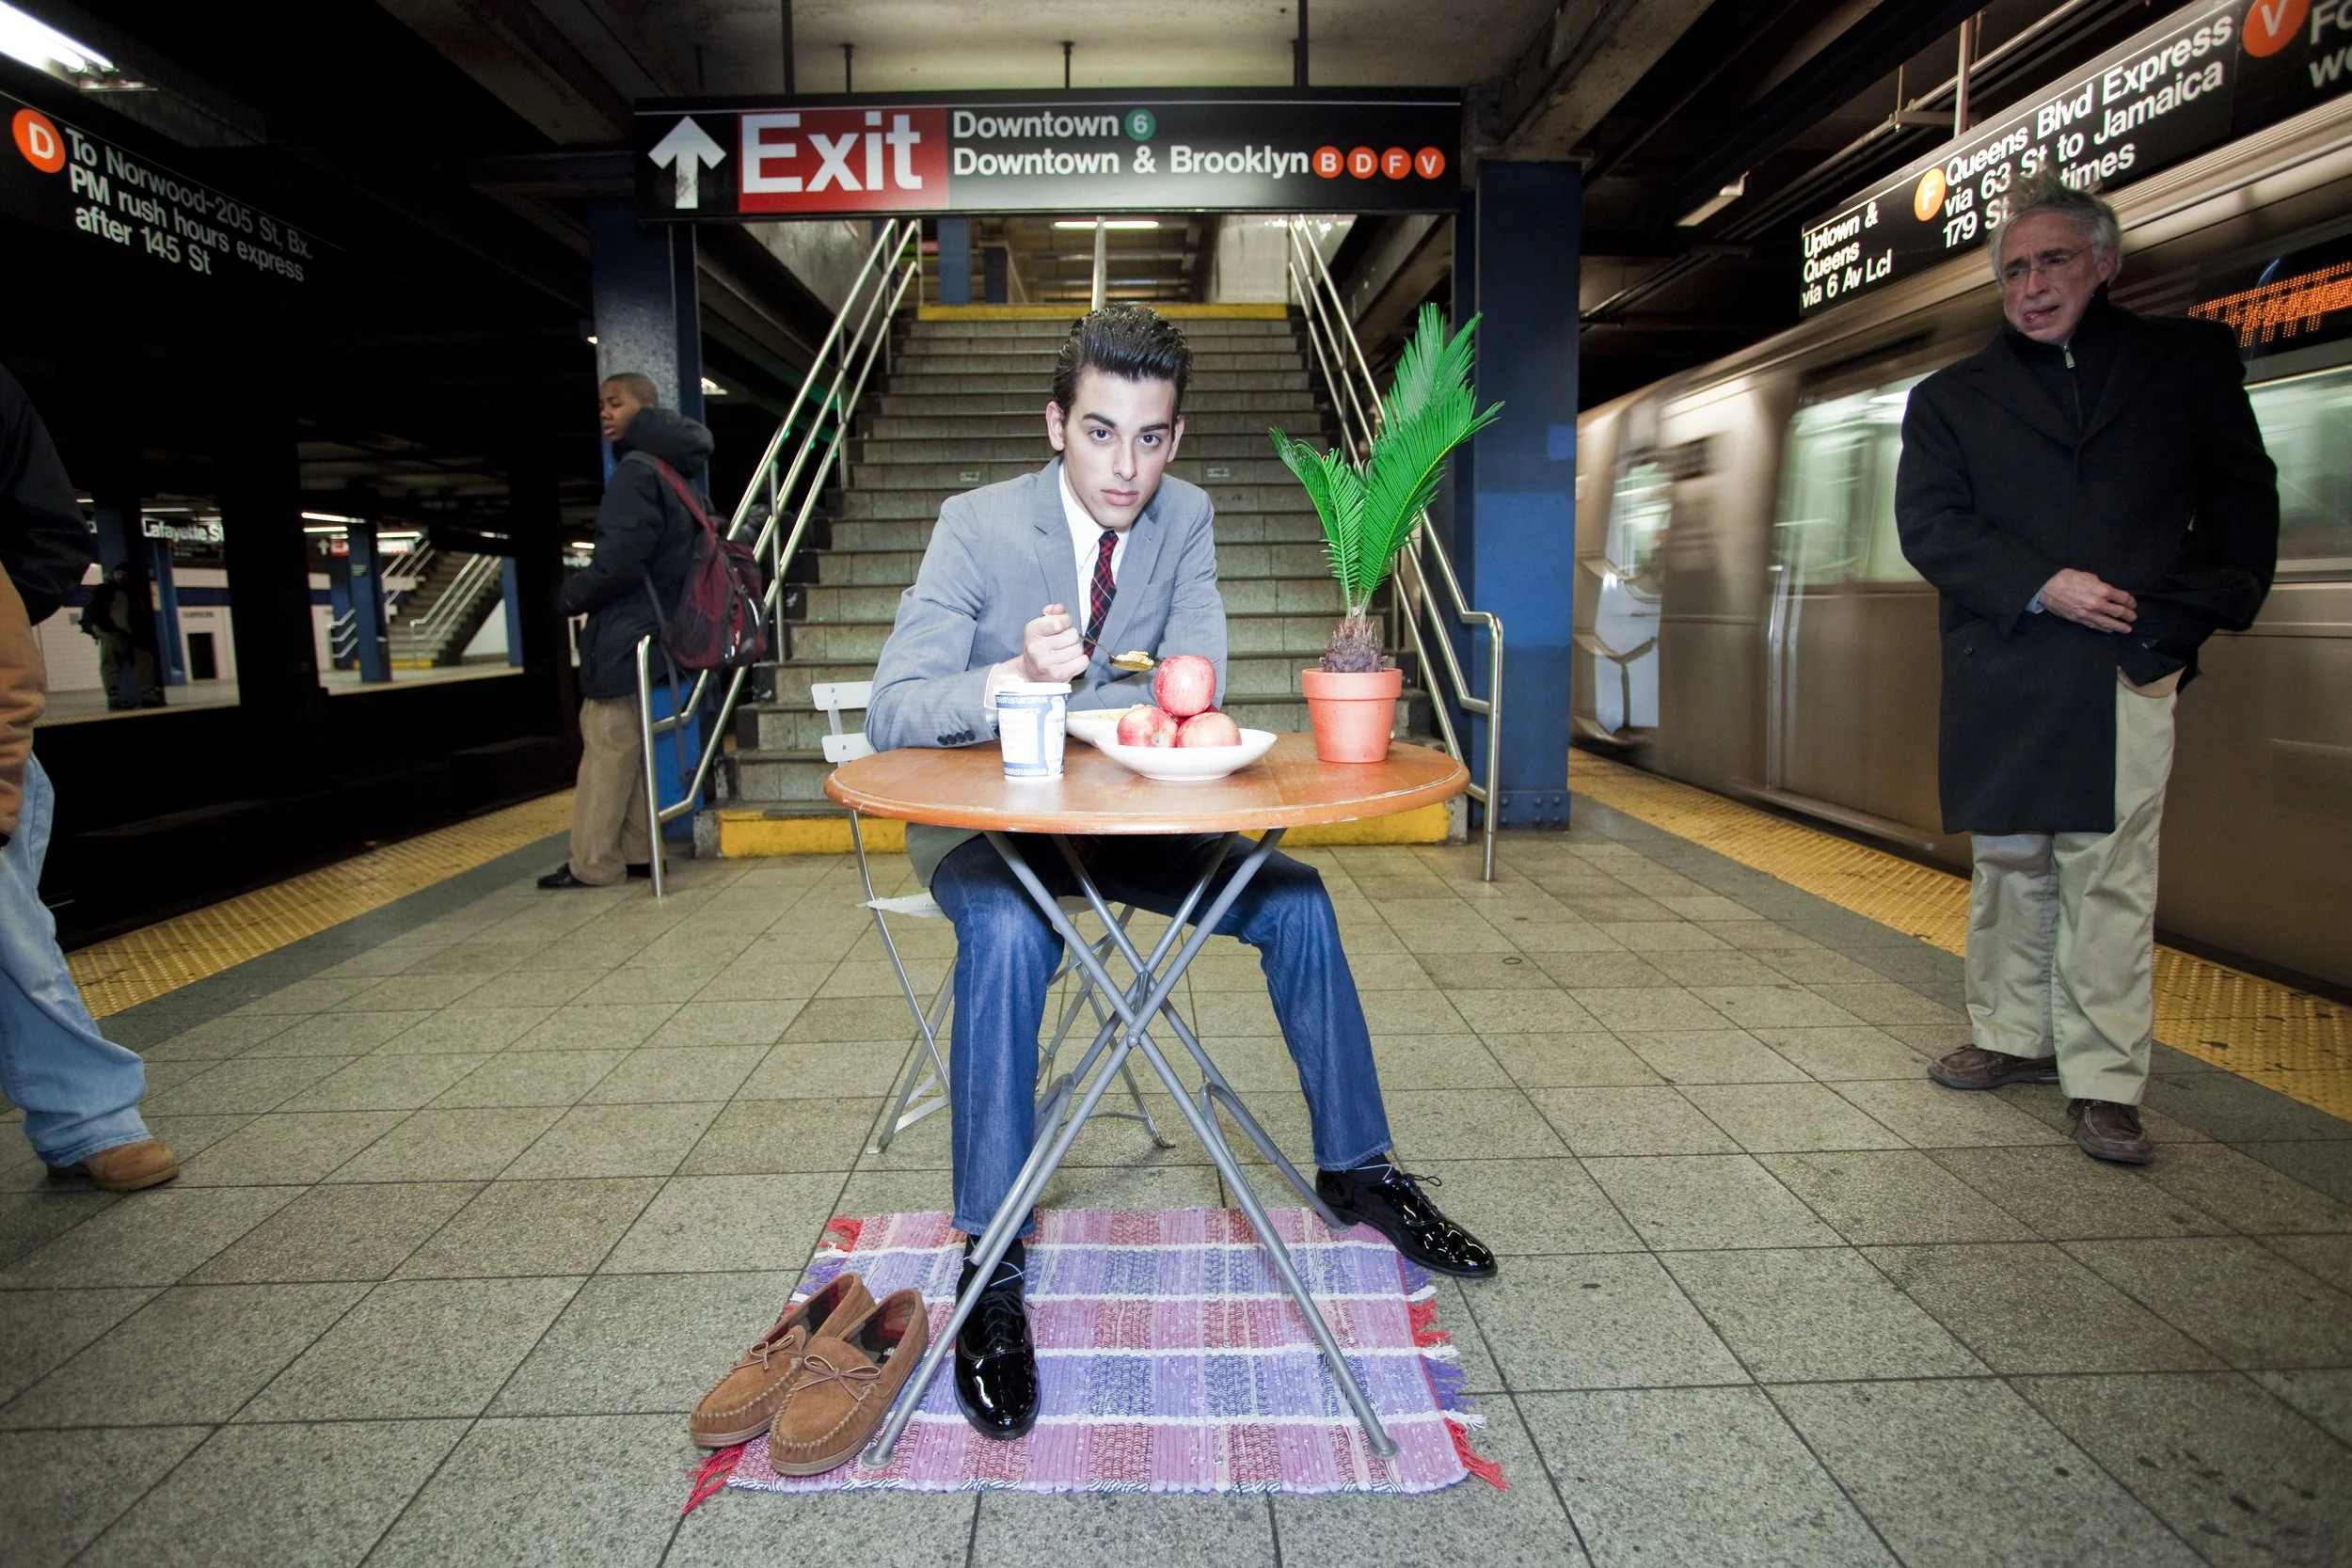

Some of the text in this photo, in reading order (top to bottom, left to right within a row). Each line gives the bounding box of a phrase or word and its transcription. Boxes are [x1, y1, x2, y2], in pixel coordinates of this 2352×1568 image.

[2261, 0, 2288, 38] V
[953, 110, 1148, 138] Downtown 6
[1921, 15, 2233, 212] F Queens Blvd Express
[1944, 61, 2223, 218] via 63 St to Jamaica
[741, 111, 923, 194] Exit
[953, 145, 1437, 179] Downtown & Brooklyn B D F V
[28, 121, 55, 159] D
[65, 127, 98, 167] To
[104, 145, 253, 234] Norwood-205
[286, 228, 313, 261] Bx.
[70, 163, 305, 282] PM rush hours express
[1942, 210, 1978, 248] 179
[2059, 143, 2136, 193] times
[75, 206, 213, 276] after 145 St
[1803, 241, 1860, 283] Queens
[1804, 201, 1879, 259] Uptown &
[1802, 248, 1893, 309] via 6 Av Lcl
[141, 517, 208, 542] Lafayette
